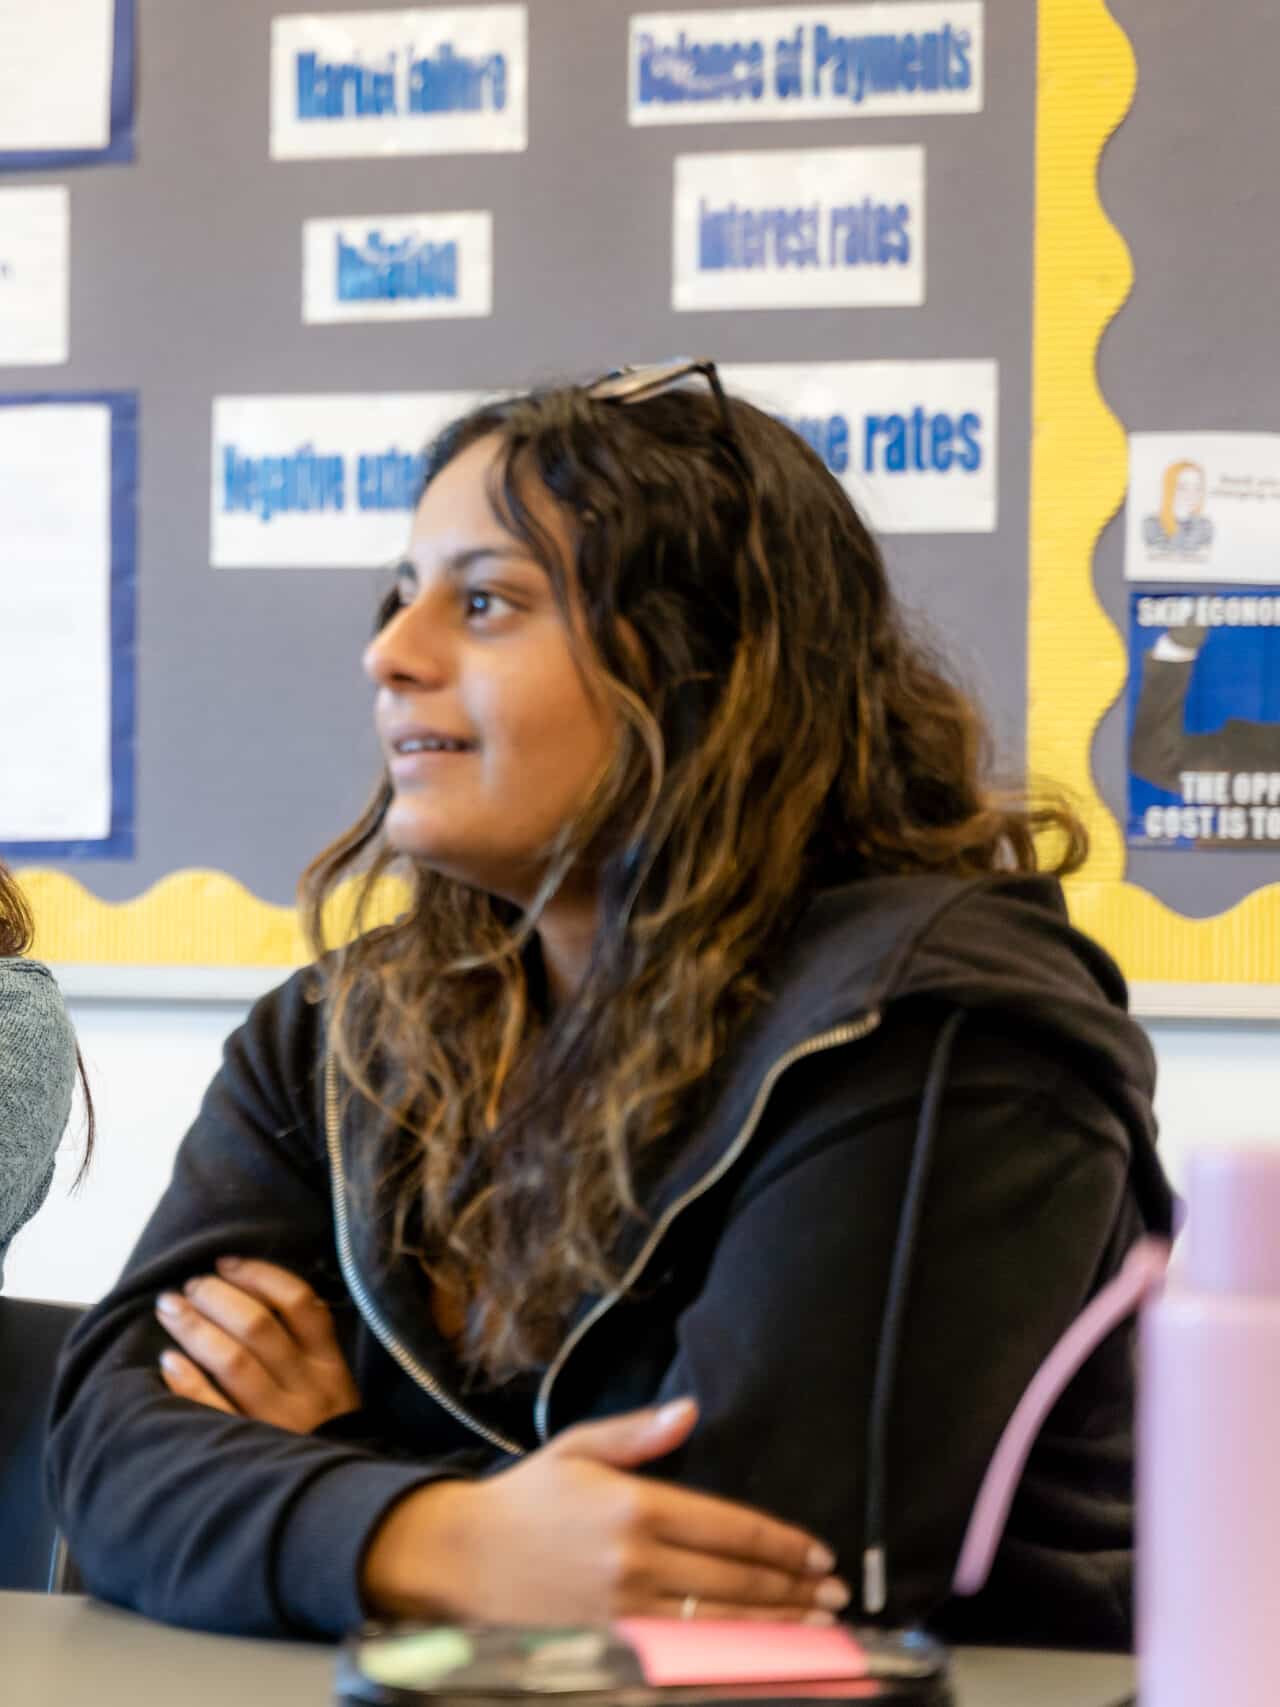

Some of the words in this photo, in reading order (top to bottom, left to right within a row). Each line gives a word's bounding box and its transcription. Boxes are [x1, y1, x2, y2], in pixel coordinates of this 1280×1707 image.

[638, 31, 764, 104] Balance
[774, 24, 804, 99] of
[813, 23, 971, 105] Payments
[698, 196, 819, 271] Interest
[829, 196, 910, 268] rates
[862, 403, 983, 475] rates
[222, 443, 345, 524] Negative
[1136, 596, 1195, 627] SKIP
[1196, 595, 1280, 628] ECONO
[1144, 804, 1214, 839] COST
[1217, 805, 1248, 840] IS
[1179, 770, 1231, 805] THE
